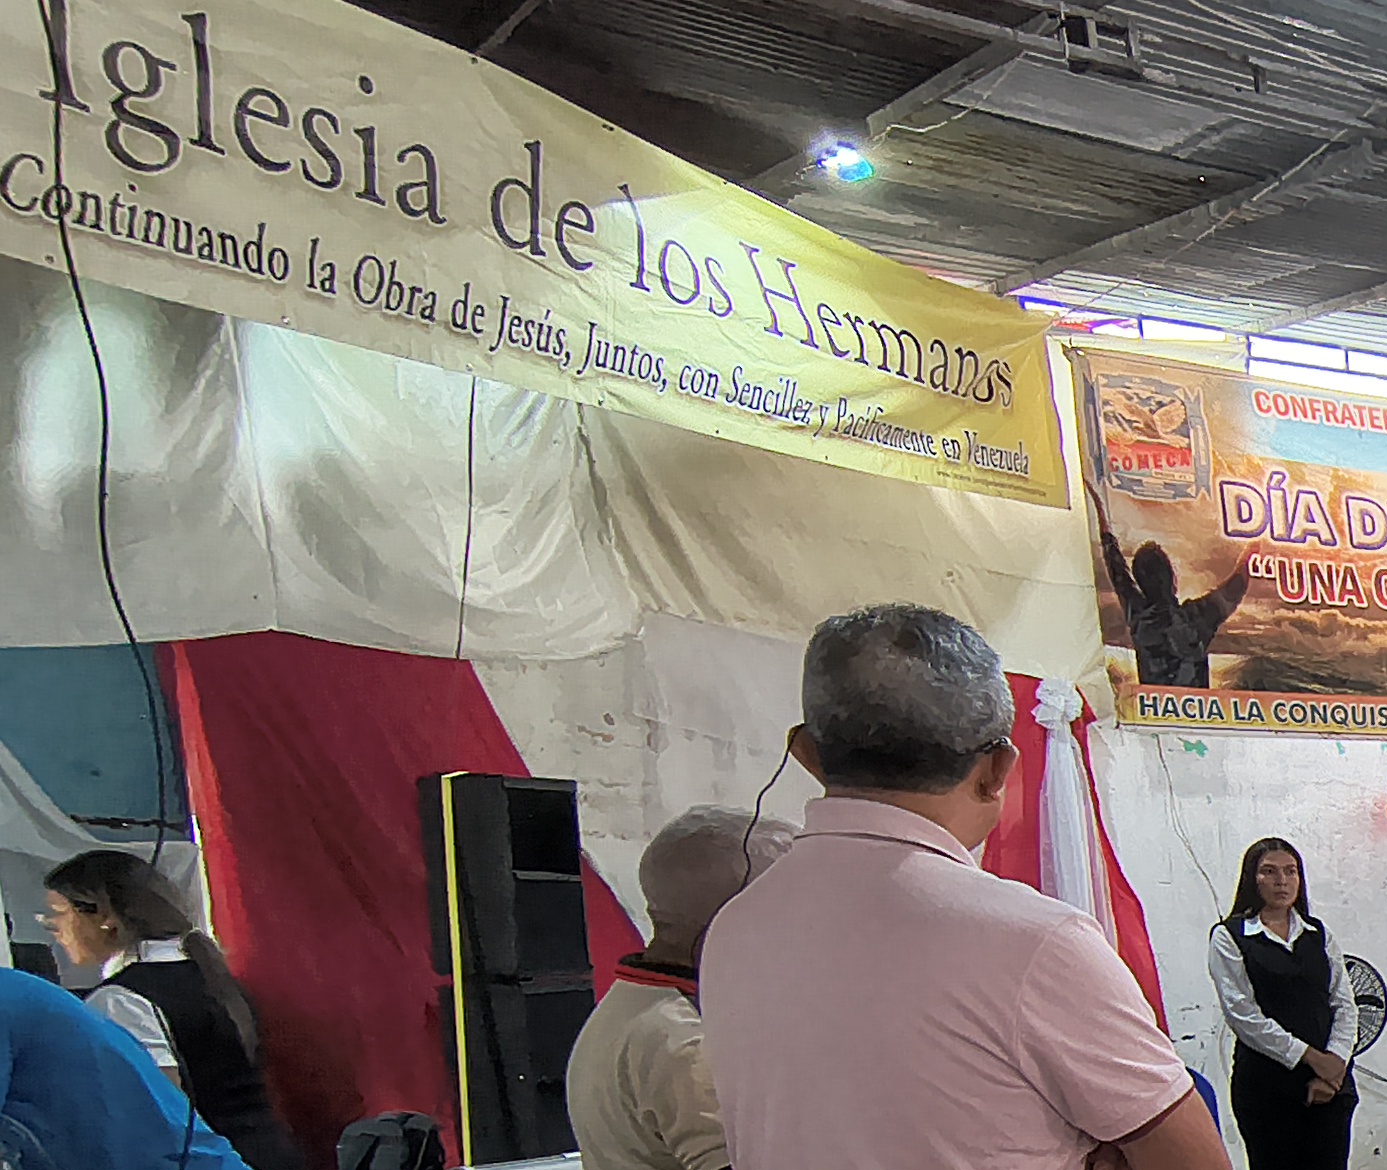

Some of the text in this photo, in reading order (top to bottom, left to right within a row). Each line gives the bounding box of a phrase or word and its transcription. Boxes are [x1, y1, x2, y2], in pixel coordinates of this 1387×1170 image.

[38, 0, 1013, 408] Iglesia de los Hermanos
[0, 153, 1030, 476] Continuando la Obra de Jesús, Juntos, con Sencillez y Pacíficamente en Venezuela
[1219, 471, 1337, 548] DÍA
[1139, 695, 1224, 721] HACIA
[1233, 699, 1261, 722] LA
